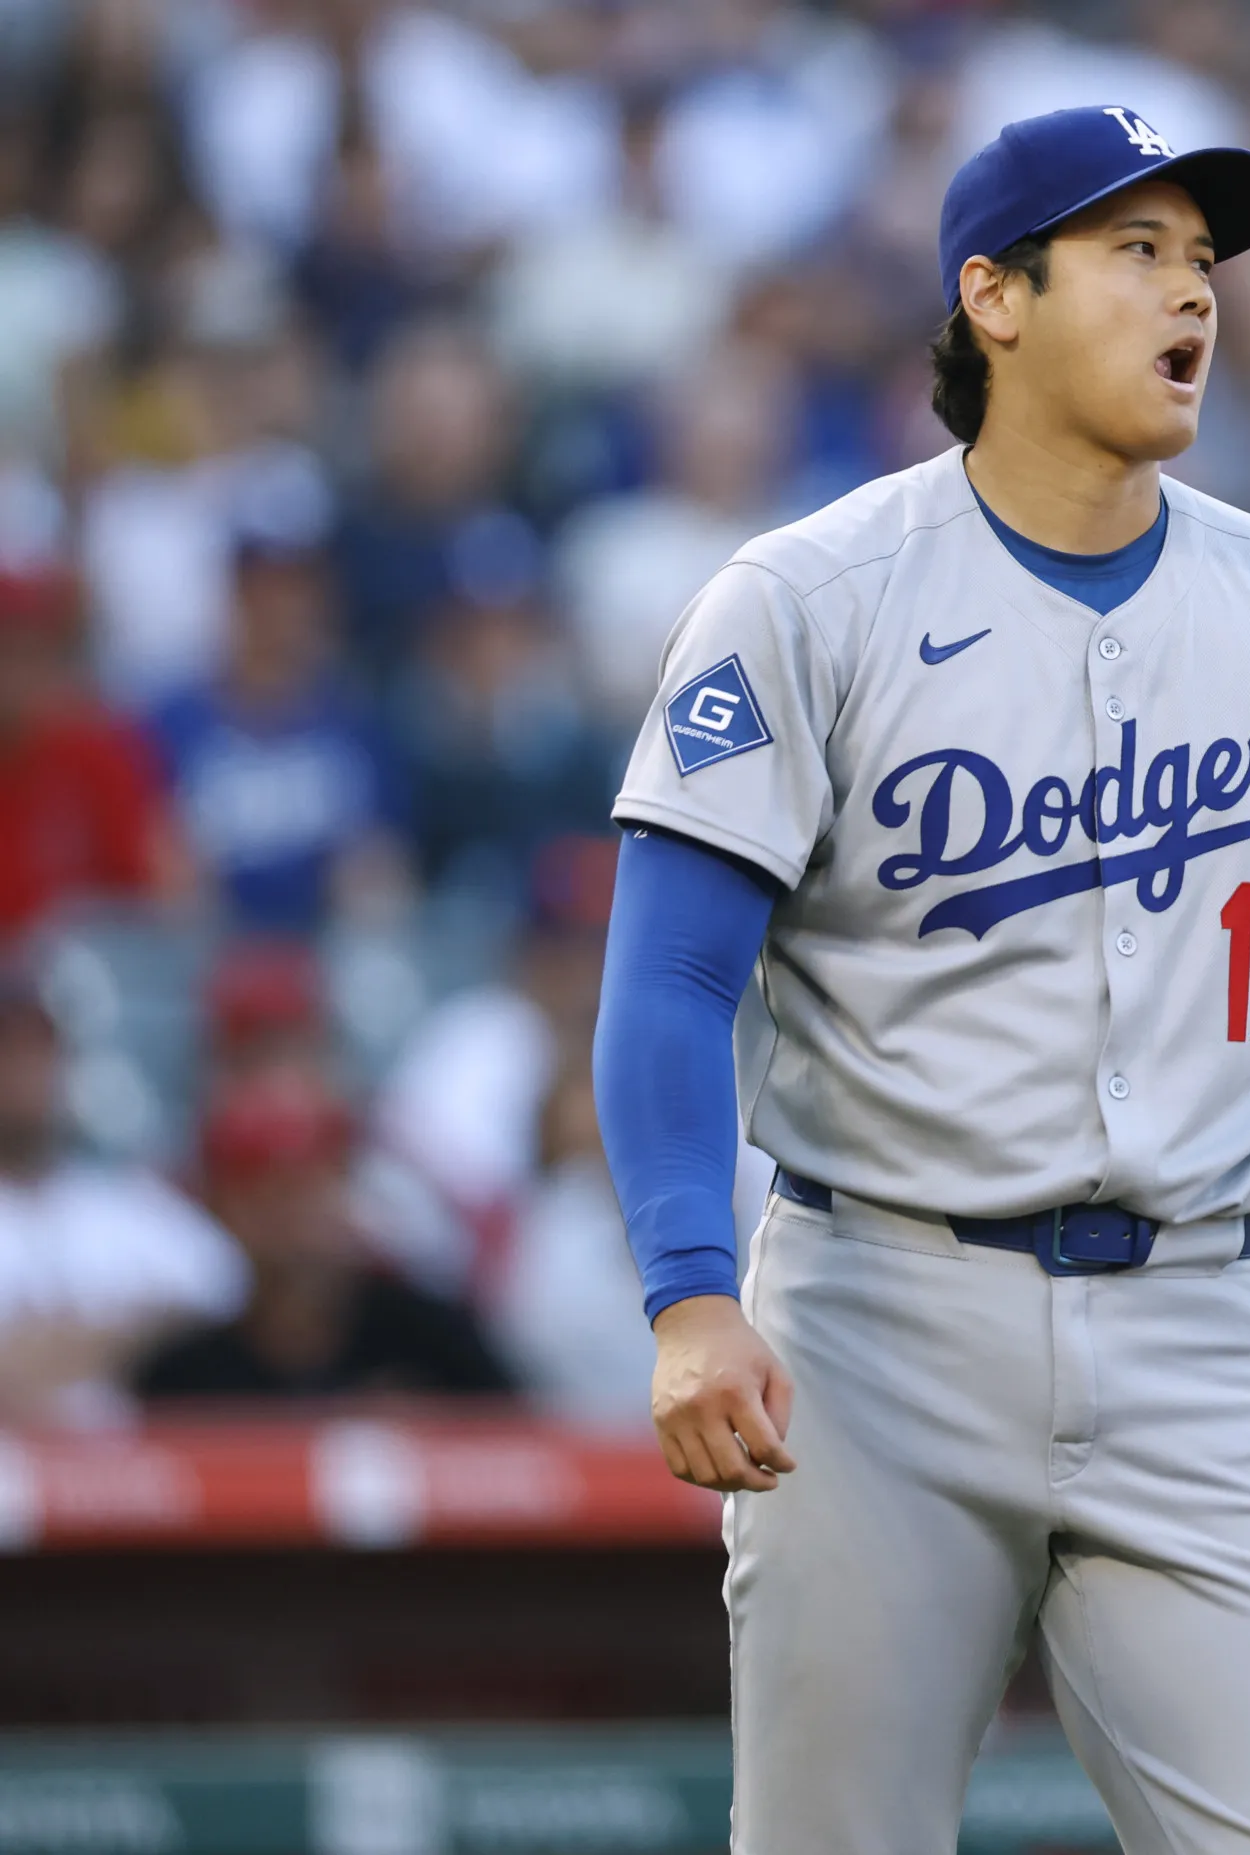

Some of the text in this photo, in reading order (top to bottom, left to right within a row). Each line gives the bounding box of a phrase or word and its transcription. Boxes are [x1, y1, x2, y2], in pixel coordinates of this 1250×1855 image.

[1102, 107, 1177, 159] LA
[688, 686, 741, 732] G
[672, 723, 734, 749] GUGGENHEIM
